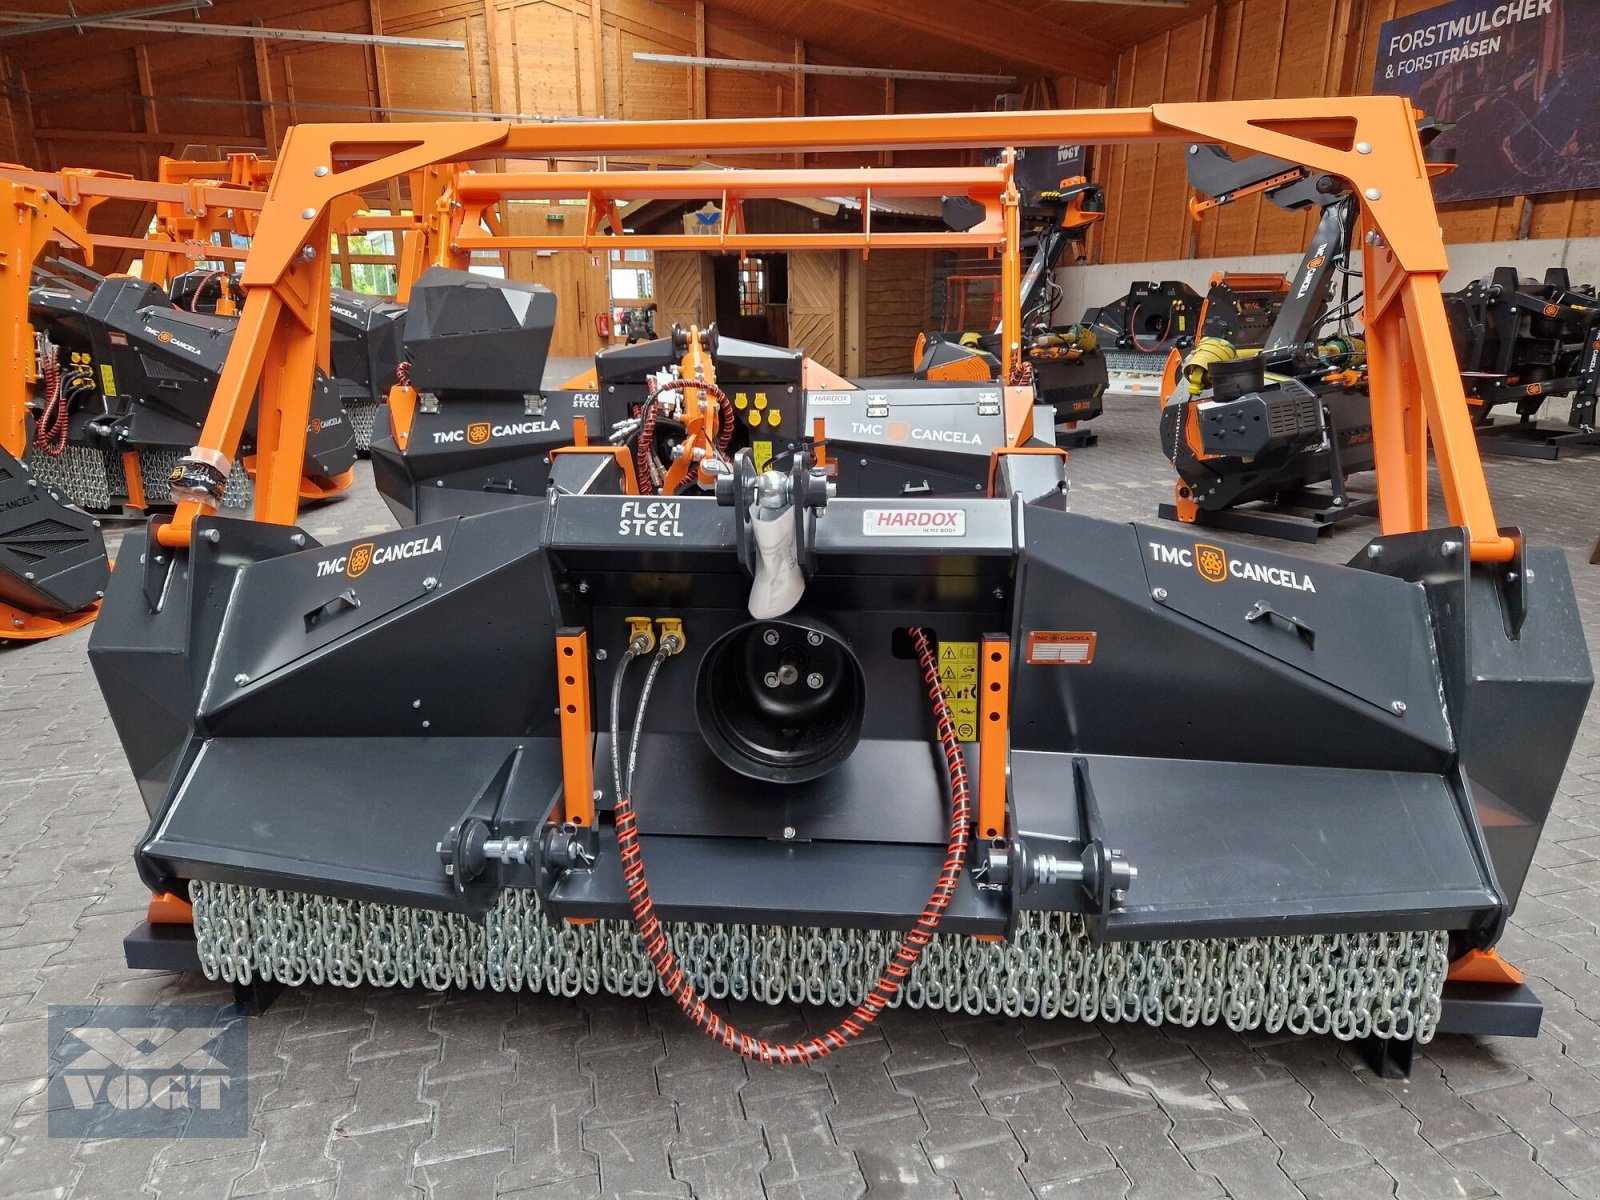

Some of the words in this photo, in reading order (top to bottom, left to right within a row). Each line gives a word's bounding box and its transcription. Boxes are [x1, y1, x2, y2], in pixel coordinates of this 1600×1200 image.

[1389, 0, 1552, 56] FORSTMULCHER
[1385, 64, 1394, 79] &
[1397, 36, 1501, 76] FORSTFRÄSEN
[170, 338, 201, 355] CANCELA
[572, 400, 600, 408] STEEL
[574, 393, 599, 401] FLEXI
[432, 430, 464, 444] TMC
[492, 419, 560, 437] CANCELA
[851, 422, 883, 436] TMC
[911, 427, 983, 446] CANCELA
[620, 501, 681, 519] FLEXI
[877, 512, 958, 526] HARDOX
[618, 519, 684, 537] STEEL
[316, 556, 348, 577] TMC
[372, 535, 443, 565] CANCELA
[1149, 542, 1194, 568] TMC
[1229, 559, 1317, 594] CANCELA
